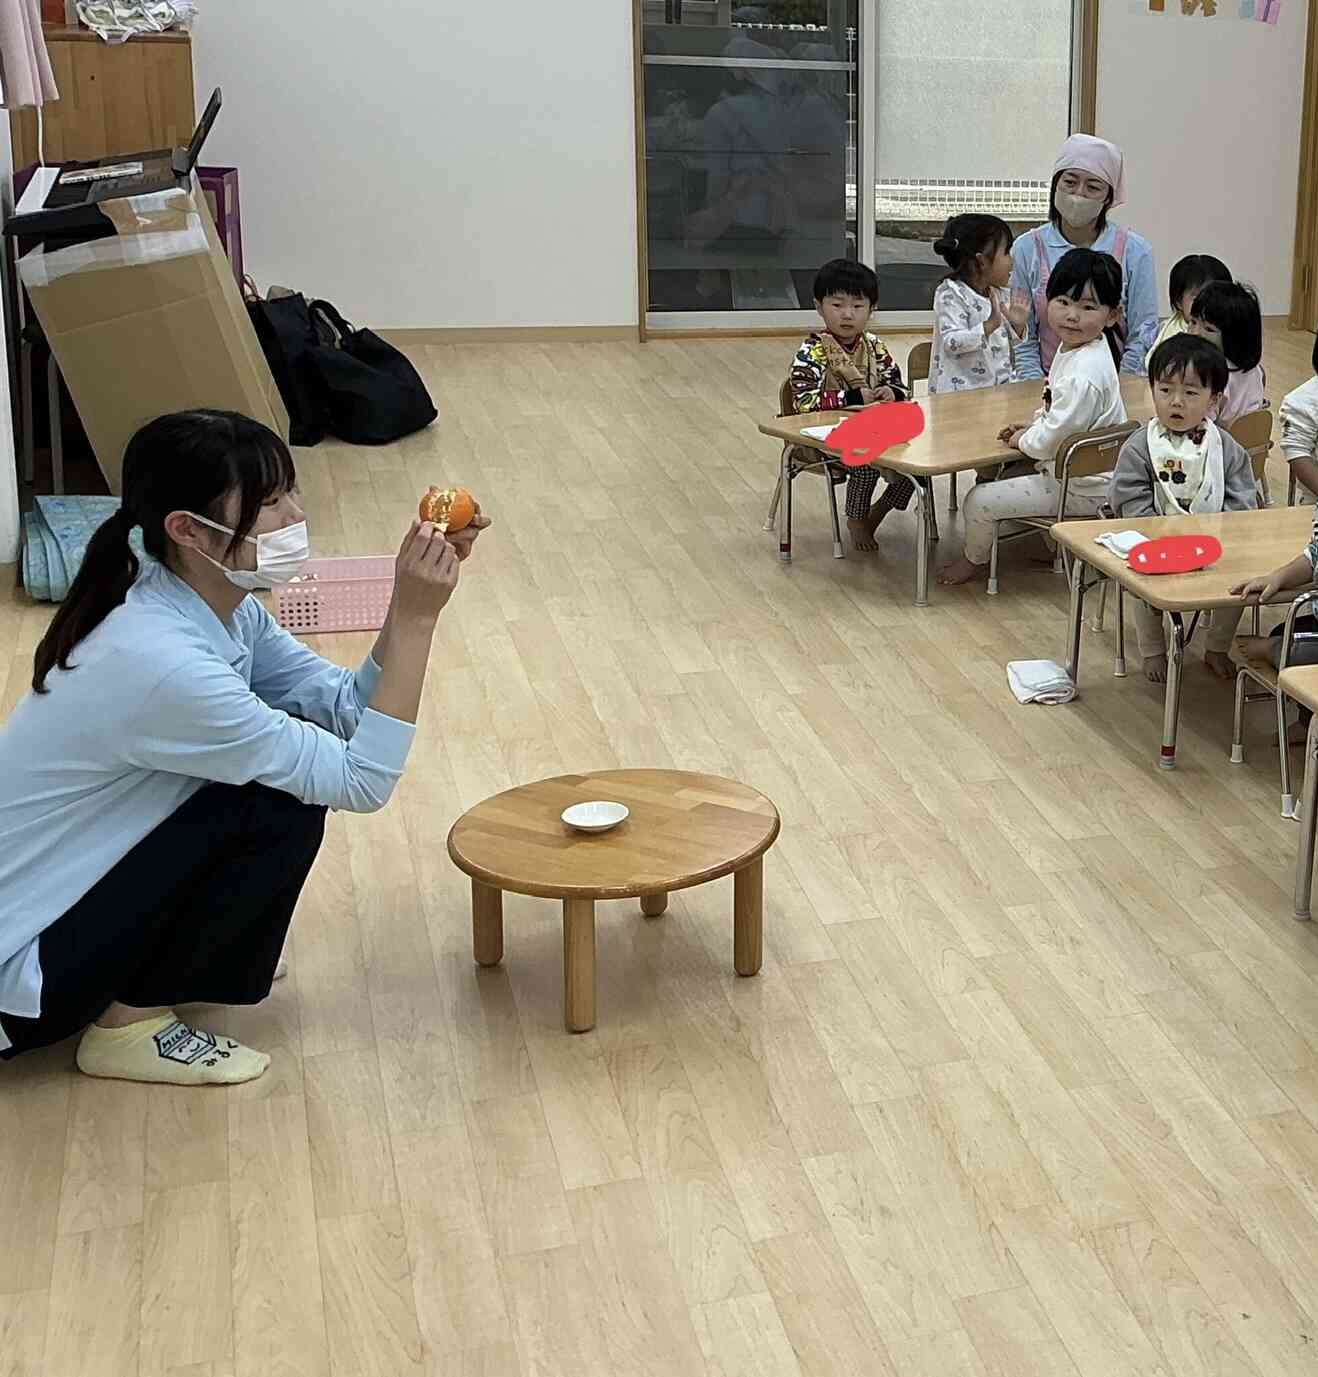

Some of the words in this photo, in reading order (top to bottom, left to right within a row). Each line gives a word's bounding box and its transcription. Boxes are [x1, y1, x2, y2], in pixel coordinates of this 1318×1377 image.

[162, 1027, 188, 1049] MILK
[201, 1040, 239, 1067] みるく
